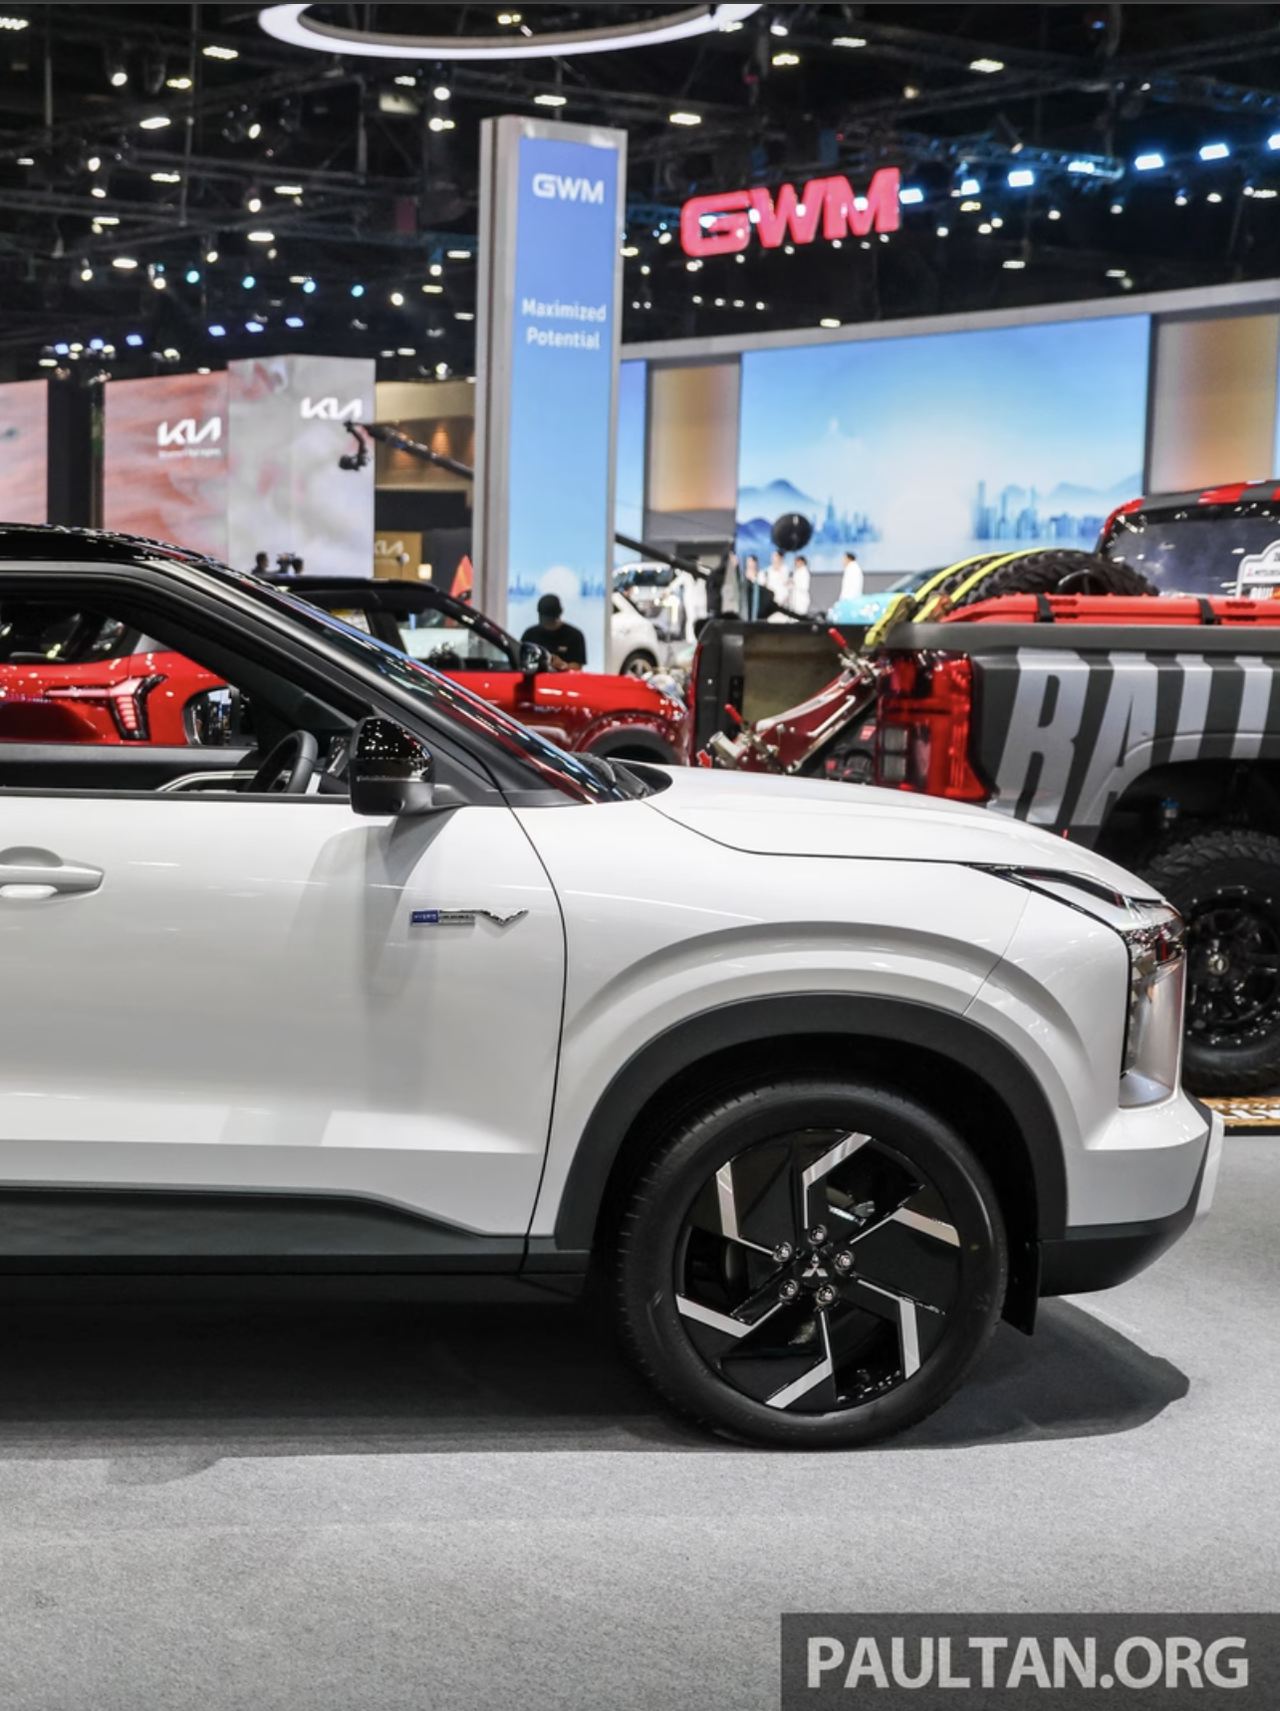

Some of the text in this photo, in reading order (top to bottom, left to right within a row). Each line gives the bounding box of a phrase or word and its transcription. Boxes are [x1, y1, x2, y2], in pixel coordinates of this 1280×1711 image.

[532, 173, 604, 204] GWM
[681, 167, 900, 257] GWM
[522, 298, 606, 322] Maximized
[526, 326, 600, 349] Potential
[300, 397, 362, 420] KIA
[157, 417, 221, 446] KIA
